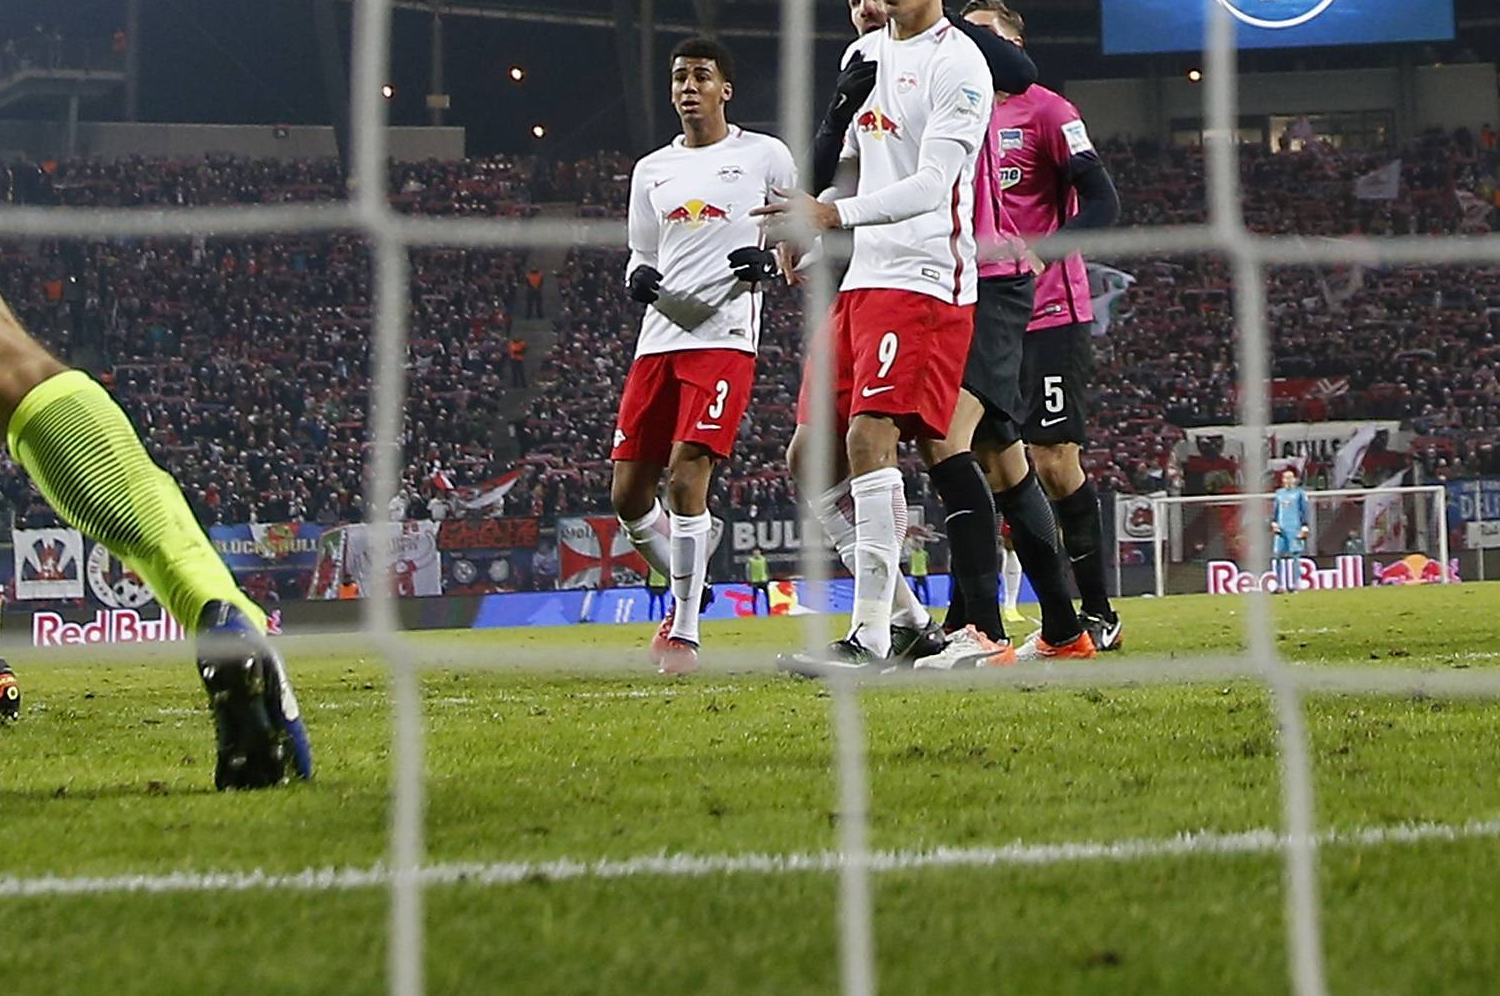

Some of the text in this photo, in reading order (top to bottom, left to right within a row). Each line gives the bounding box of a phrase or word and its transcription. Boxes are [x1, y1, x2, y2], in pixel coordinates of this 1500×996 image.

[877, 332, 898, 379] 9
[708, 379, 729, 420] 3
[1043, 375, 1064, 413] 5
[1208, 555, 1363, 595] Red Bull
[34, 609, 109, 647] Red
